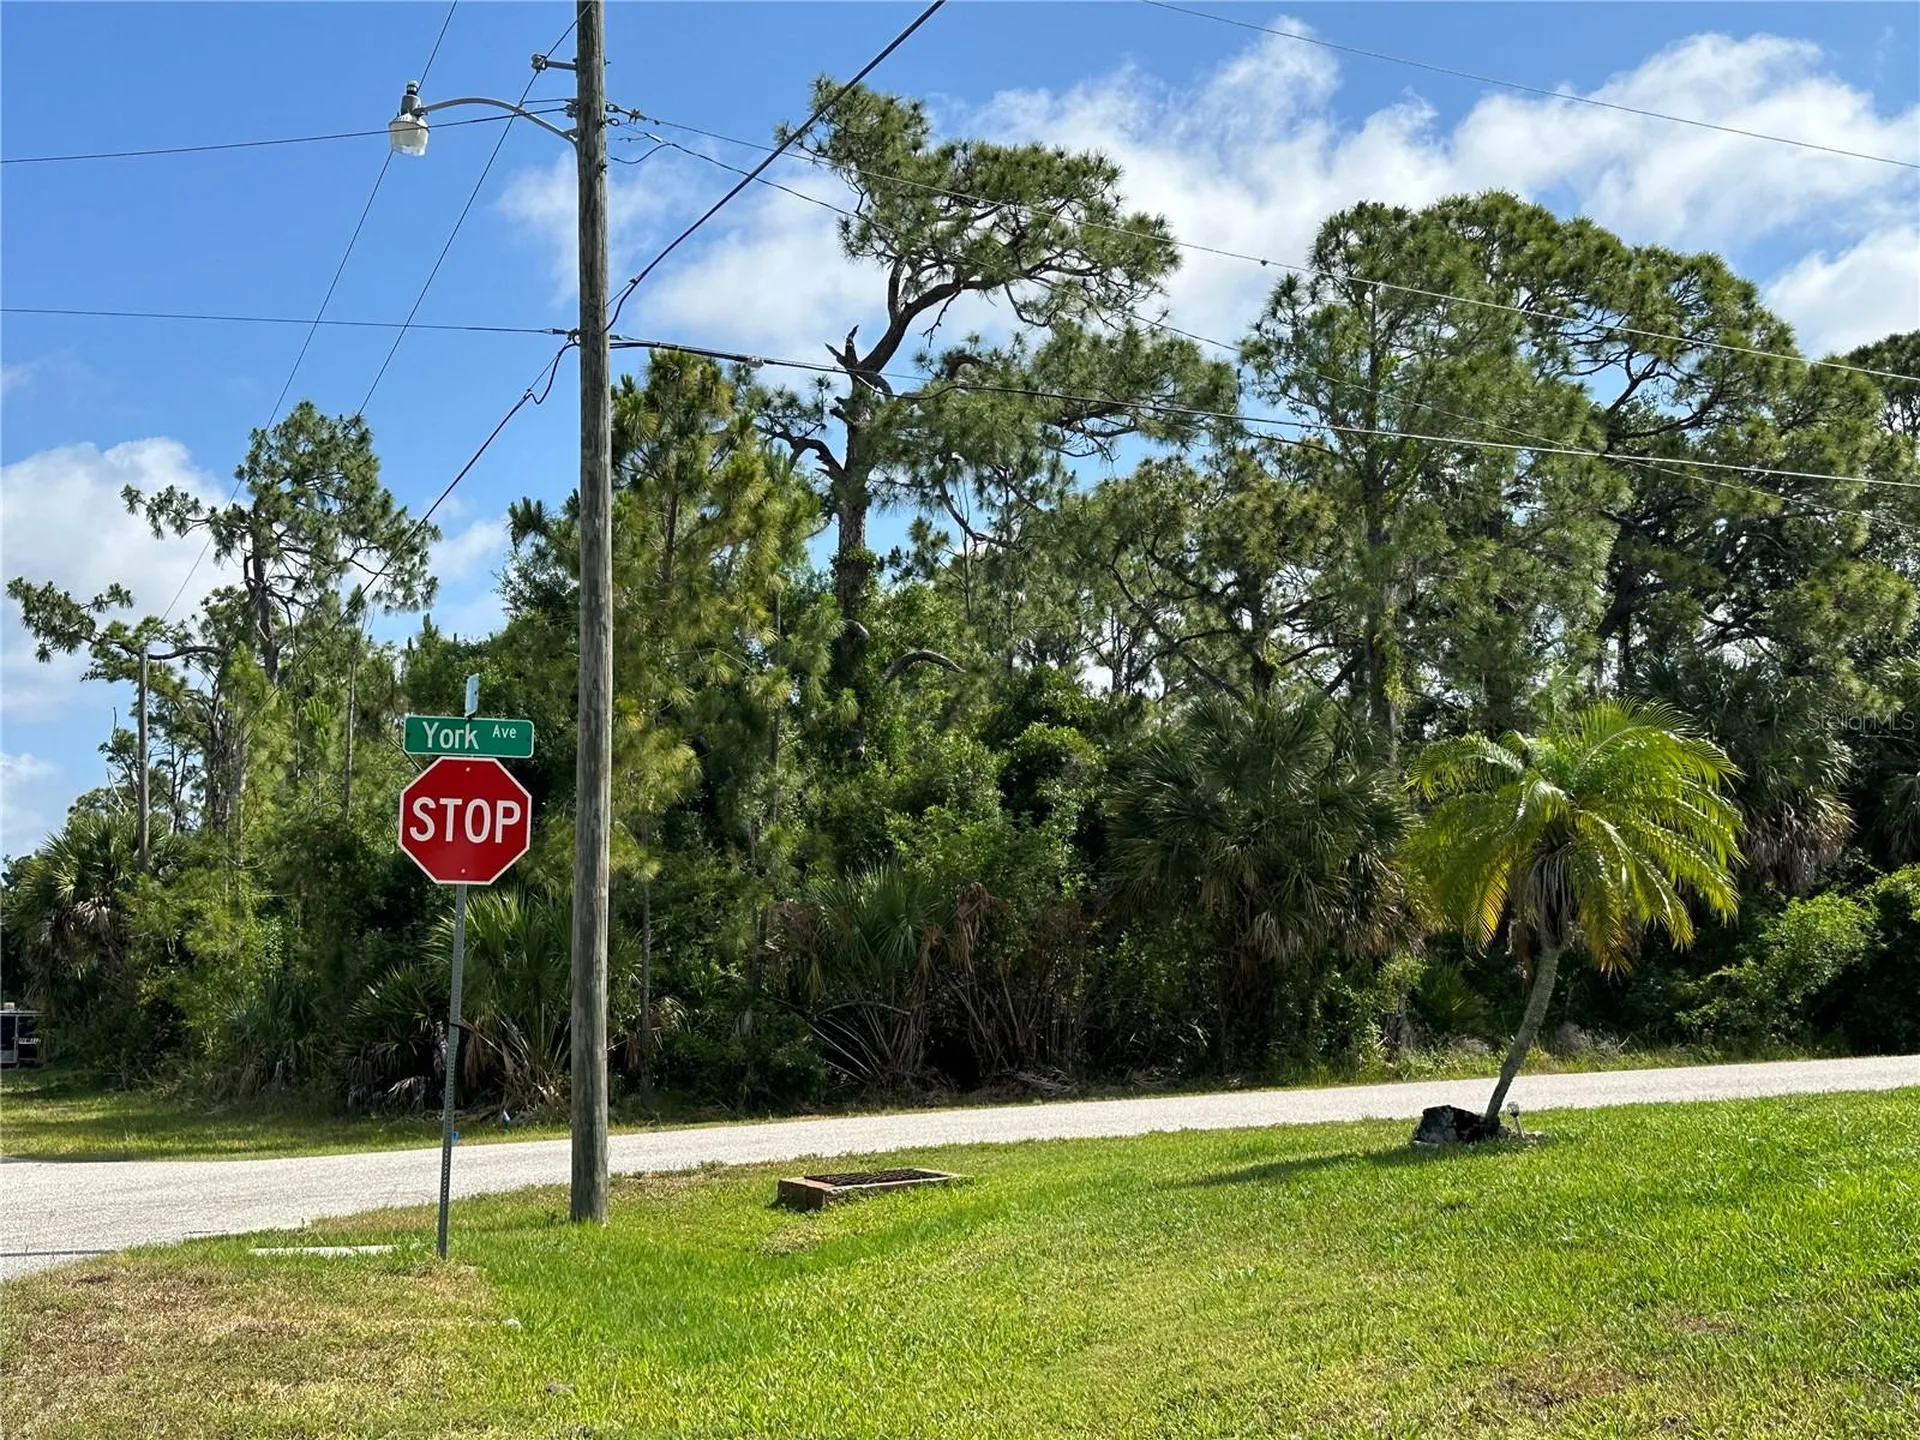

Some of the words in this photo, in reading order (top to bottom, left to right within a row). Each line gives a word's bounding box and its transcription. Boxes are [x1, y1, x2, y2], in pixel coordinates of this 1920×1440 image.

[422, 721, 479, 750] York
[492, 725, 517, 739] Ave
[409, 796, 521, 843] STOP
